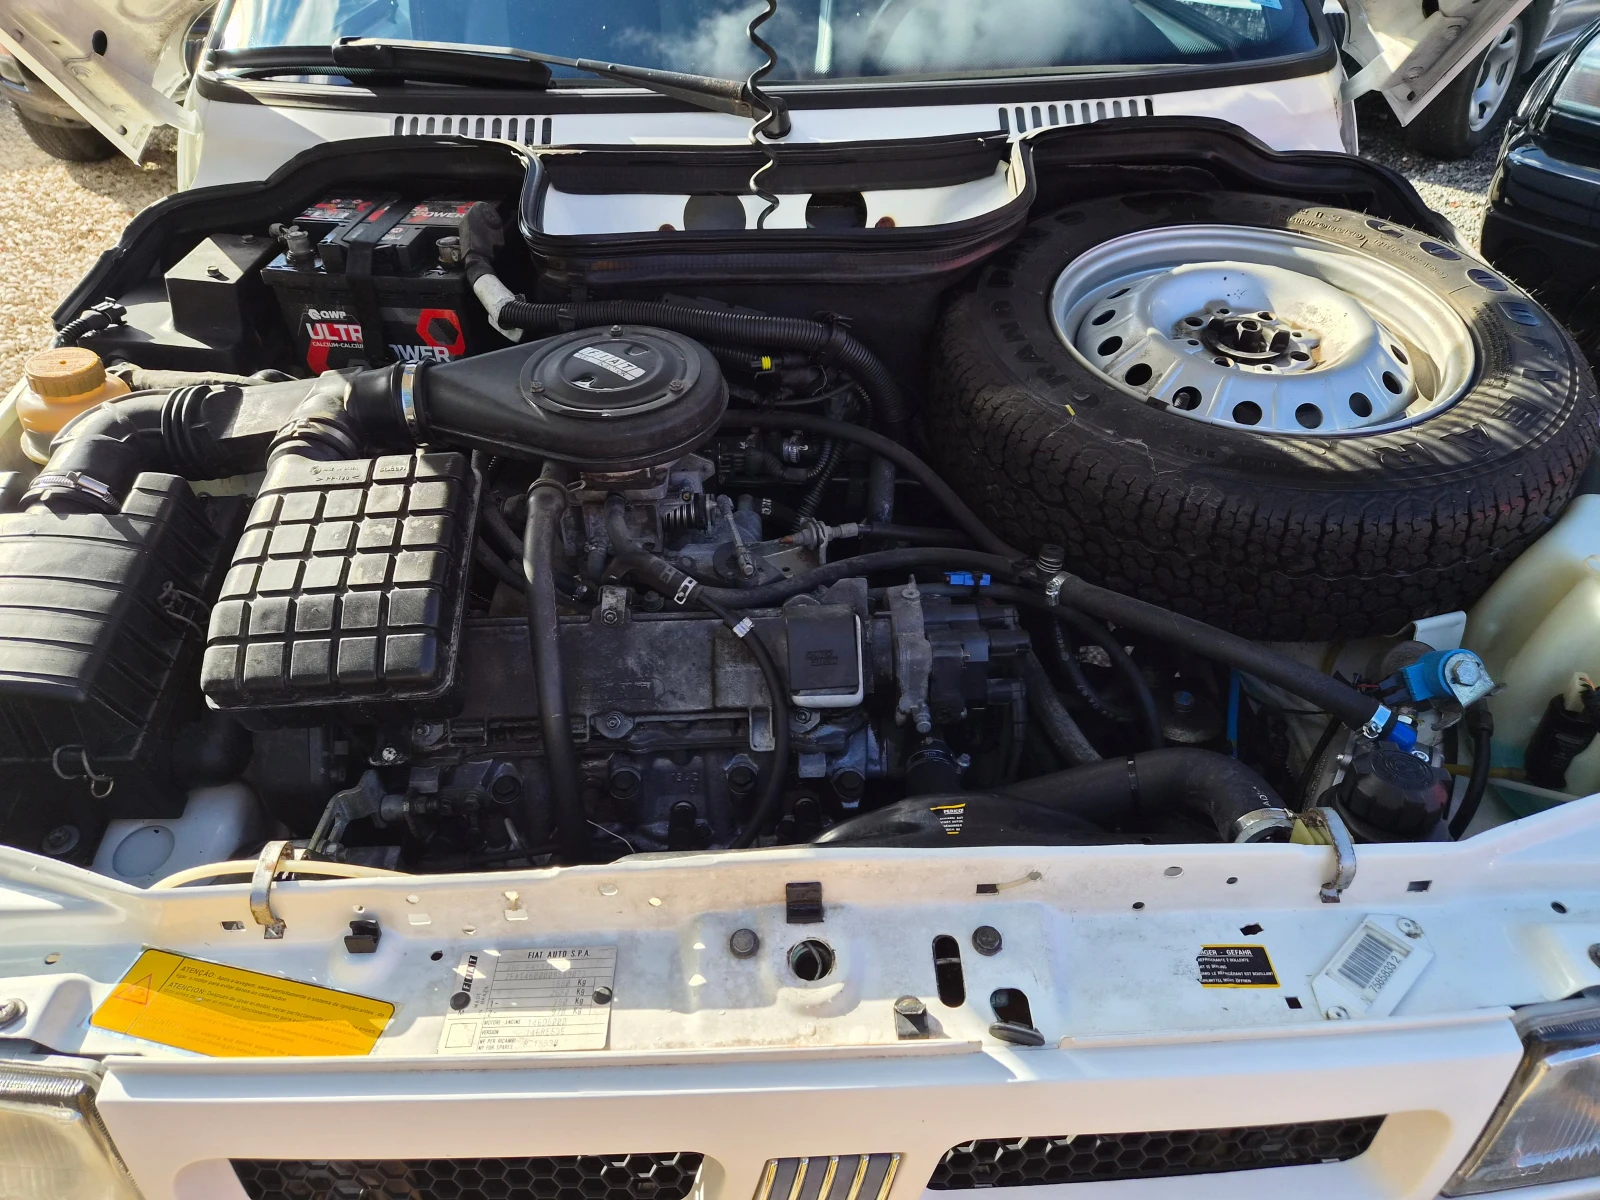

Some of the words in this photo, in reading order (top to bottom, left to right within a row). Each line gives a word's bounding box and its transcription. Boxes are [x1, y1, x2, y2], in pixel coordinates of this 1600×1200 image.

[320, 310, 347, 319] QWP
[305, 323, 363, 341] ULTR
[587, 349, 635, 369] FIAT
[528, 951, 543, 959] FIAT
[462, 955, 478, 992] FIAT
[1368, 960, 1397, 993] 7585833
[577, 979, 587, 987] Kg
[576, 988, 586, 996] Kg
[574, 998, 584, 1006] Kg
[572, 1007, 582, 1015] Kg
